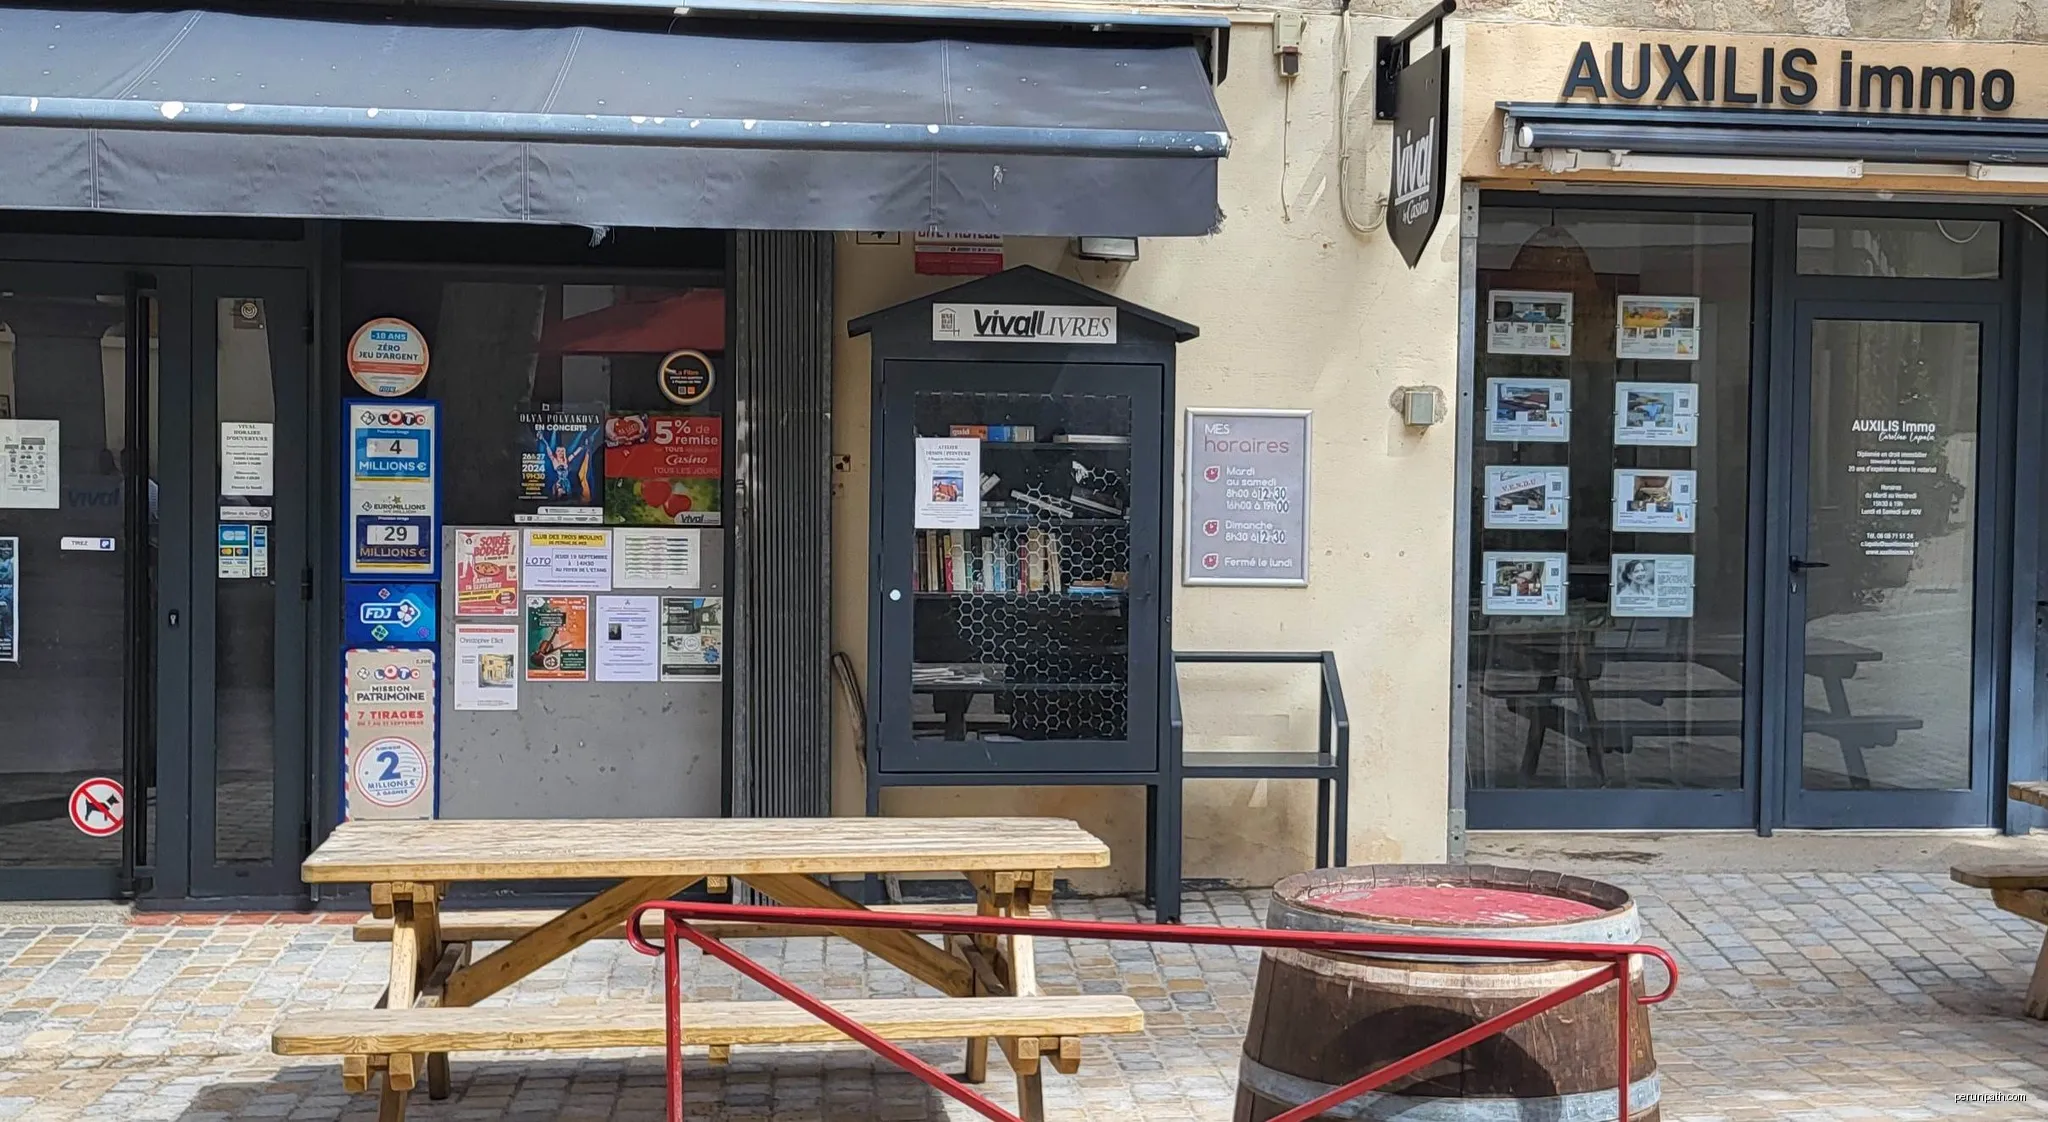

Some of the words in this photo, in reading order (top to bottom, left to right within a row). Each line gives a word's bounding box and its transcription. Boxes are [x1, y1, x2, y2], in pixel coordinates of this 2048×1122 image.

[1562, 42, 1819, 105] AUXILIS
[1840, 50, 2015, 111] immo
[1396, 116, 1435, 198] Vival
[1407, 196, 1428, 224] Casino
[388, 333, 406, 341] ANS
[377, 343, 400, 351] ZÉRO
[376, 352, 419, 361] D'ARGENT
[378, 409, 425, 426] LOTO
[519, 414, 542, 422] OLYA
[547, 414, 599, 424] POLYAKOVA
[696, 424, 710, 433] de
[1204, 424, 1230, 434] MES
[1852, 420, 1899, 431] AUXILIS
[675, 435, 718, 445] remise
[1878, 432, 1907, 441] Caroline
[390, 440, 402, 454] 4
[1204, 436, 1290, 454] horaires
[666, 454, 708, 466] Casino
[359, 461, 415, 471] MILLIONS
[417, 462, 426, 470] €
[522, 464, 545, 472] 2024
[1226, 467, 1255, 475] Mardi
[1241, 478, 1276, 486] samedi
[1226, 489, 1248, 497] 8h00
[1252, 490, 1257, 498] à
[1226, 500, 1251, 510] 16h00
[1254, 502, 1261, 510] à
[1225, 520, 1272, 529] Dimanche
[384, 526, 407, 541] 29
[1225, 532, 1248, 541] 8h30
[1251, 532, 1256, 541] à
[480, 532, 511, 546] SOIRÉE
[360, 548, 417, 557] MILLIONS
[419, 548, 427, 557] €
[474, 546, 509, 556] BODEGA
[526, 557, 551, 565] LOTO
[1224, 557, 1255, 566] Fermé
[1258, 558, 1267, 566] le
[1270, 558, 1292, 567] lundi
[366, 608, 392, 619] FDJ
[374, 664, 420, 680] LOTO
[357, 693, 425, 701] PATRIMOINE
[358, 711, 365, 719] 7
[370, 711, 424, 719] TIRAGES
[376, 751, 401, 781] 2
[368, 780, 408, 789] MILLIONS
